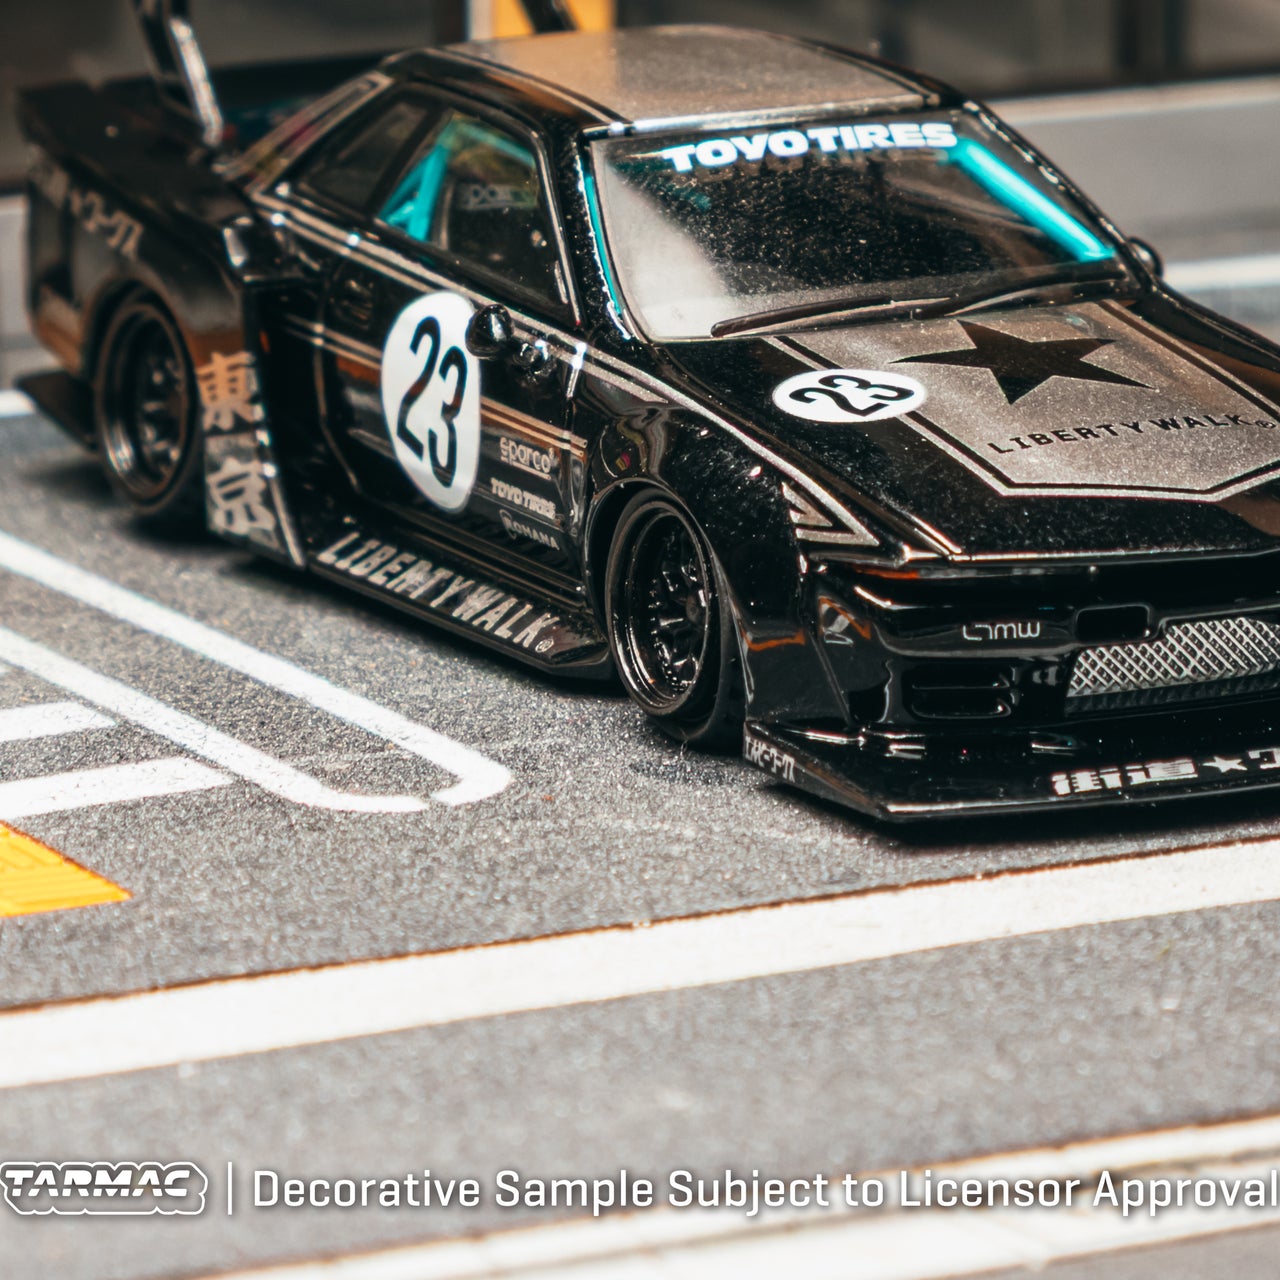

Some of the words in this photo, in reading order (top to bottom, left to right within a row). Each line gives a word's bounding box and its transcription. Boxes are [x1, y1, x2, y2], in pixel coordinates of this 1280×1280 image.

[661, 129, 809, 172] TOYO
[806, 122, 958, 153] TIRES
[396, 316, 468, 488] 23
[788, 374, 916, 417] 23
[987, 421, 1145, 455] LIBERTY
[1148, 414, 1252, 431] WALK
